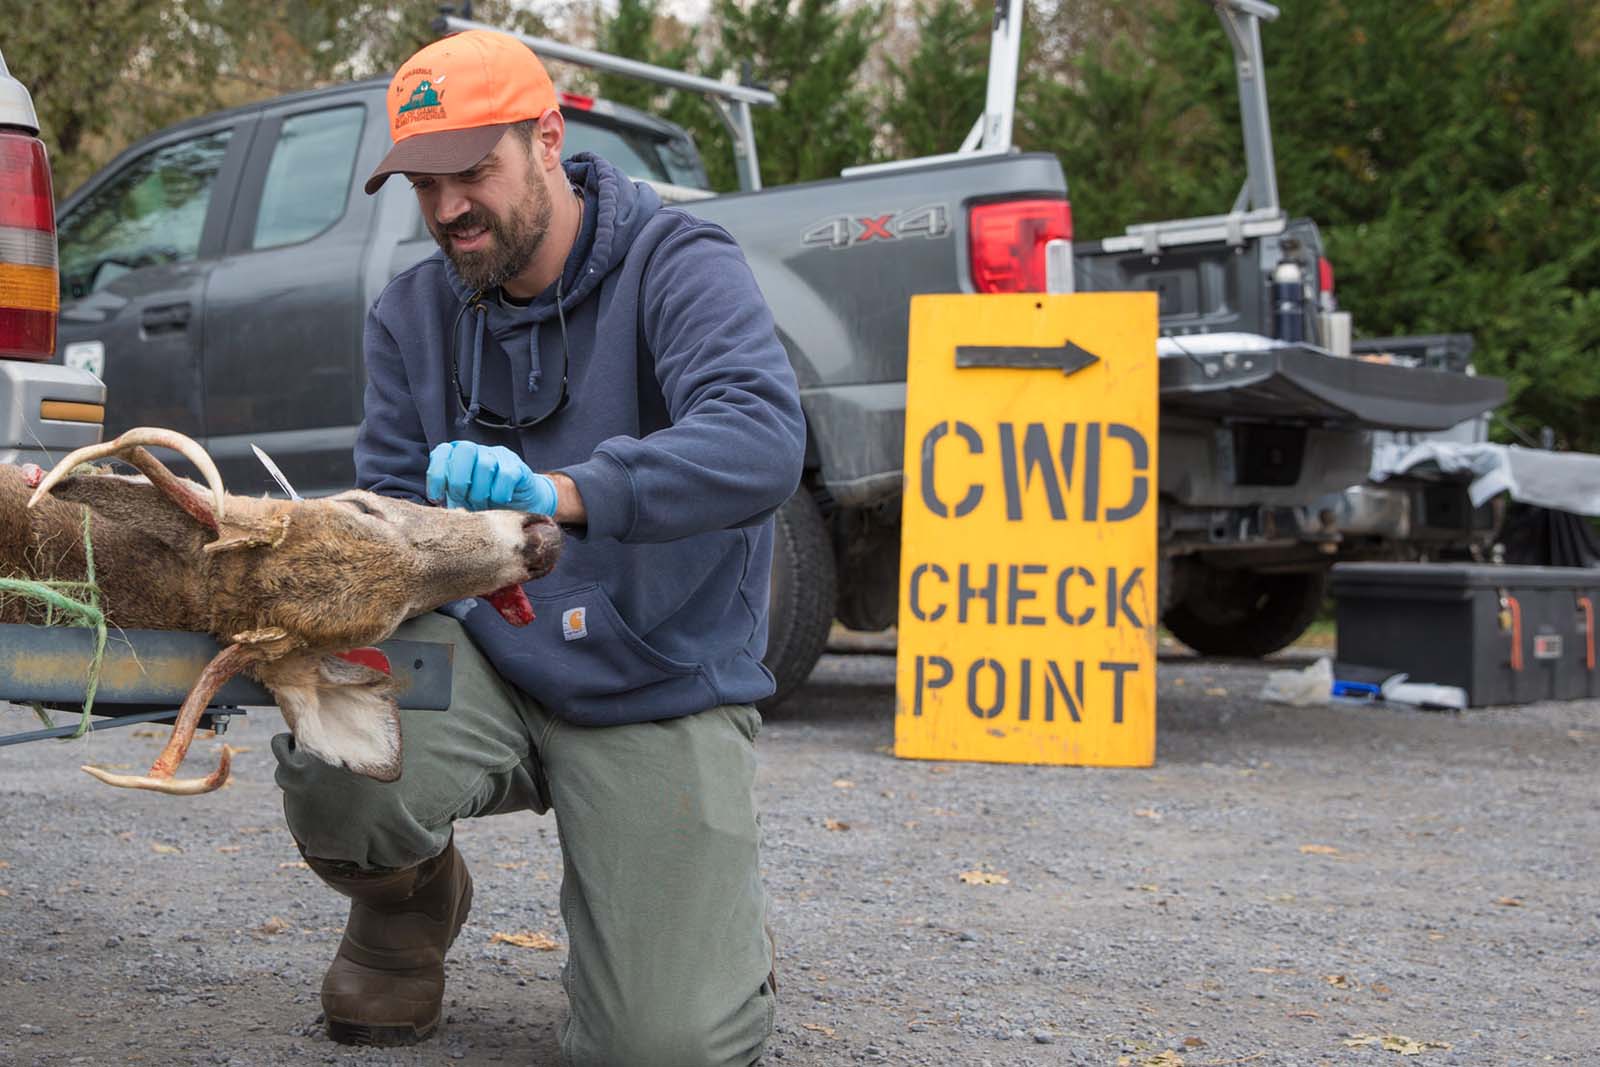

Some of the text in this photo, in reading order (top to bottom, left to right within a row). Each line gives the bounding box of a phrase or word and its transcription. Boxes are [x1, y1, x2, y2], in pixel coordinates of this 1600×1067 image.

[921, 421, 1149, 522] CWD
[909, 563, 1143, 629] CHECK
[913, 655, 1138, 724] POINT
